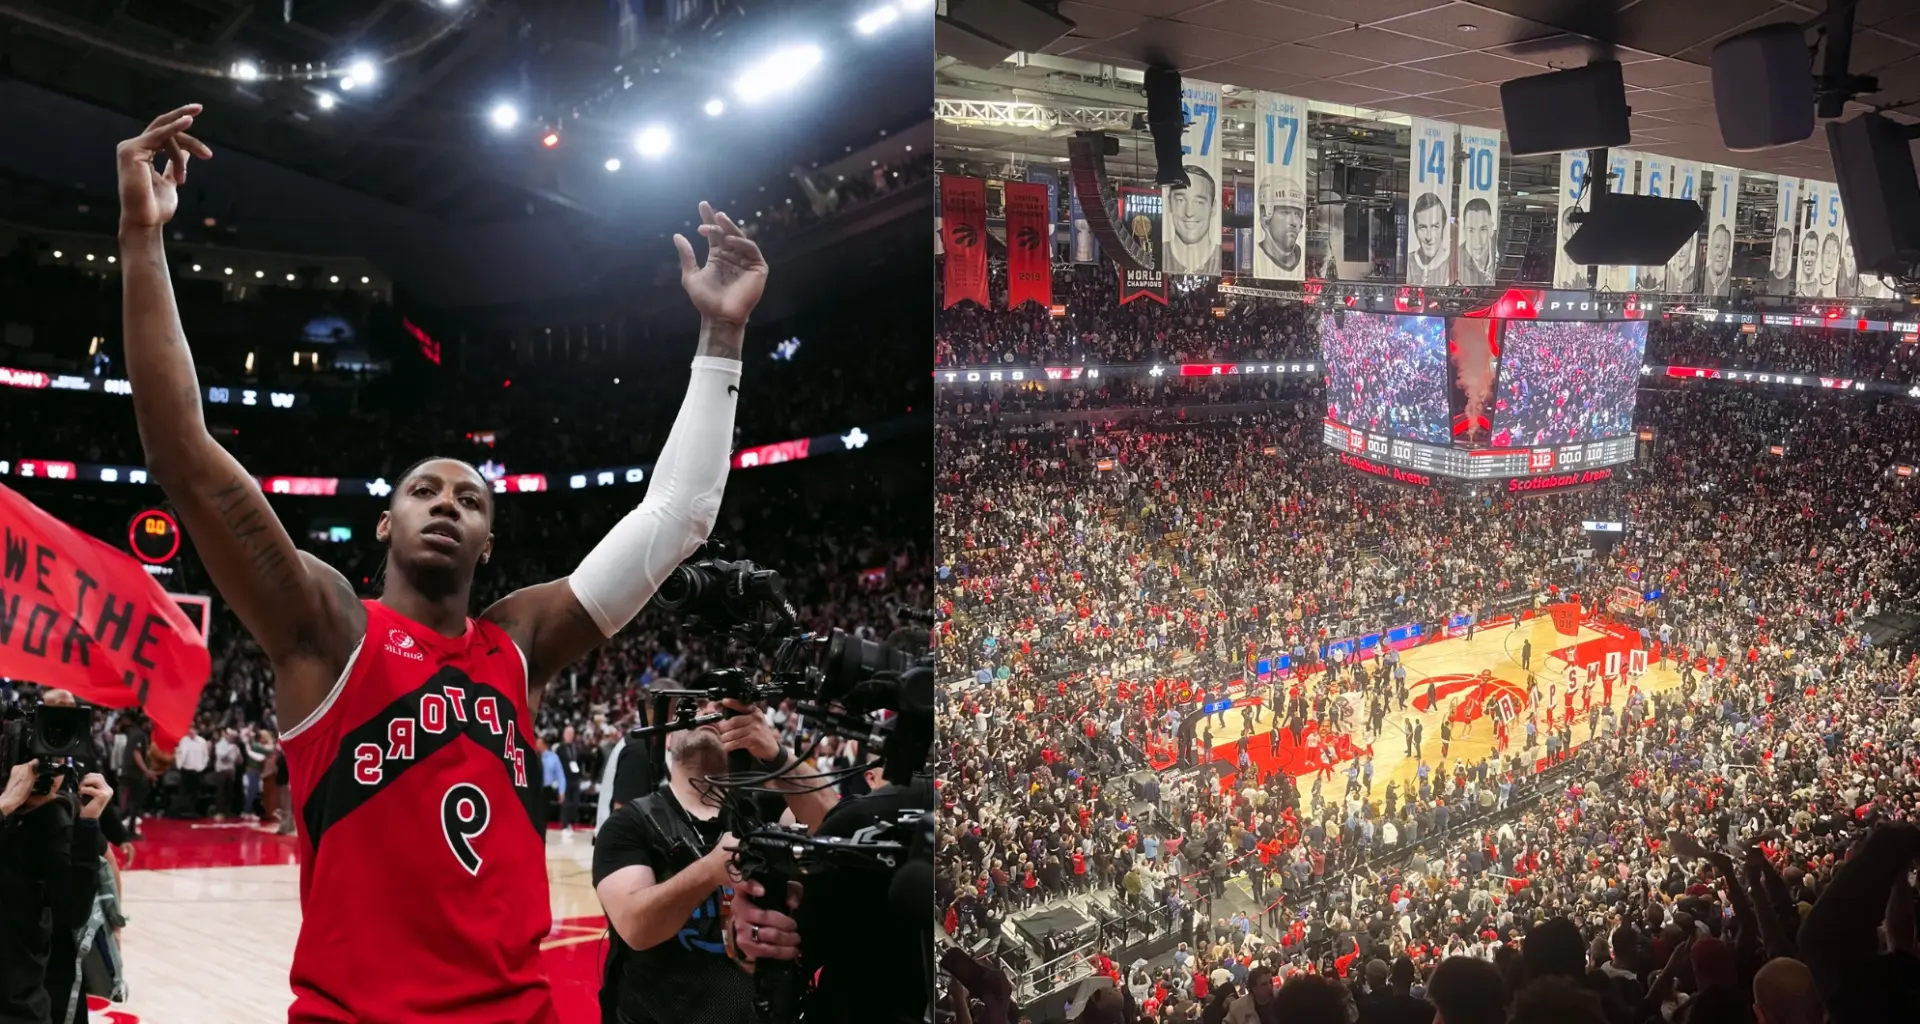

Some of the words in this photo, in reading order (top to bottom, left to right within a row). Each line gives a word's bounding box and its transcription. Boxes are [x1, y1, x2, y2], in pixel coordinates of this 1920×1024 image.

[1265, 114, 1298, 166] 17
[1419, 139, 1445, 184] 14
[1469, 147, 1492, 190] 10
[1569, 160, 1584, 199] 9
[1126, 194, 1163, 205] TORONTO
[1126, 203, 1163, 214] RAPTORS
[1828, 197, 1839, 227] 5
[1127, 269, 1162, 281] WORLD
[1126, 280, 1162, 288] CHAMPIONS
[1211, 362, 1315, 374] RAPTORS
[1695, 369, 1803, 386] RAPTORS
[1350, 434, 1363, 449] 112
[1368, 439, 1387, 455] 00.0
[1393, 446, 1411, 460] 110
[1532, 454, 1551, 467] 112
[1559, 451, 1582, 464] 00.0
[1586, 448, 1602, 461] 110
[1340, 451, 1391, 478] Scotiabank
[1393, 466, 1431, 487] Arena
[1508, 472, 1580, 492] Scotiabank
[1581, 468, 1612, 484] Arena
[1595, 522, 1608, 530] Bell
[4, 526, 56, 596] WE
[75, 569, 171, 672] THE
